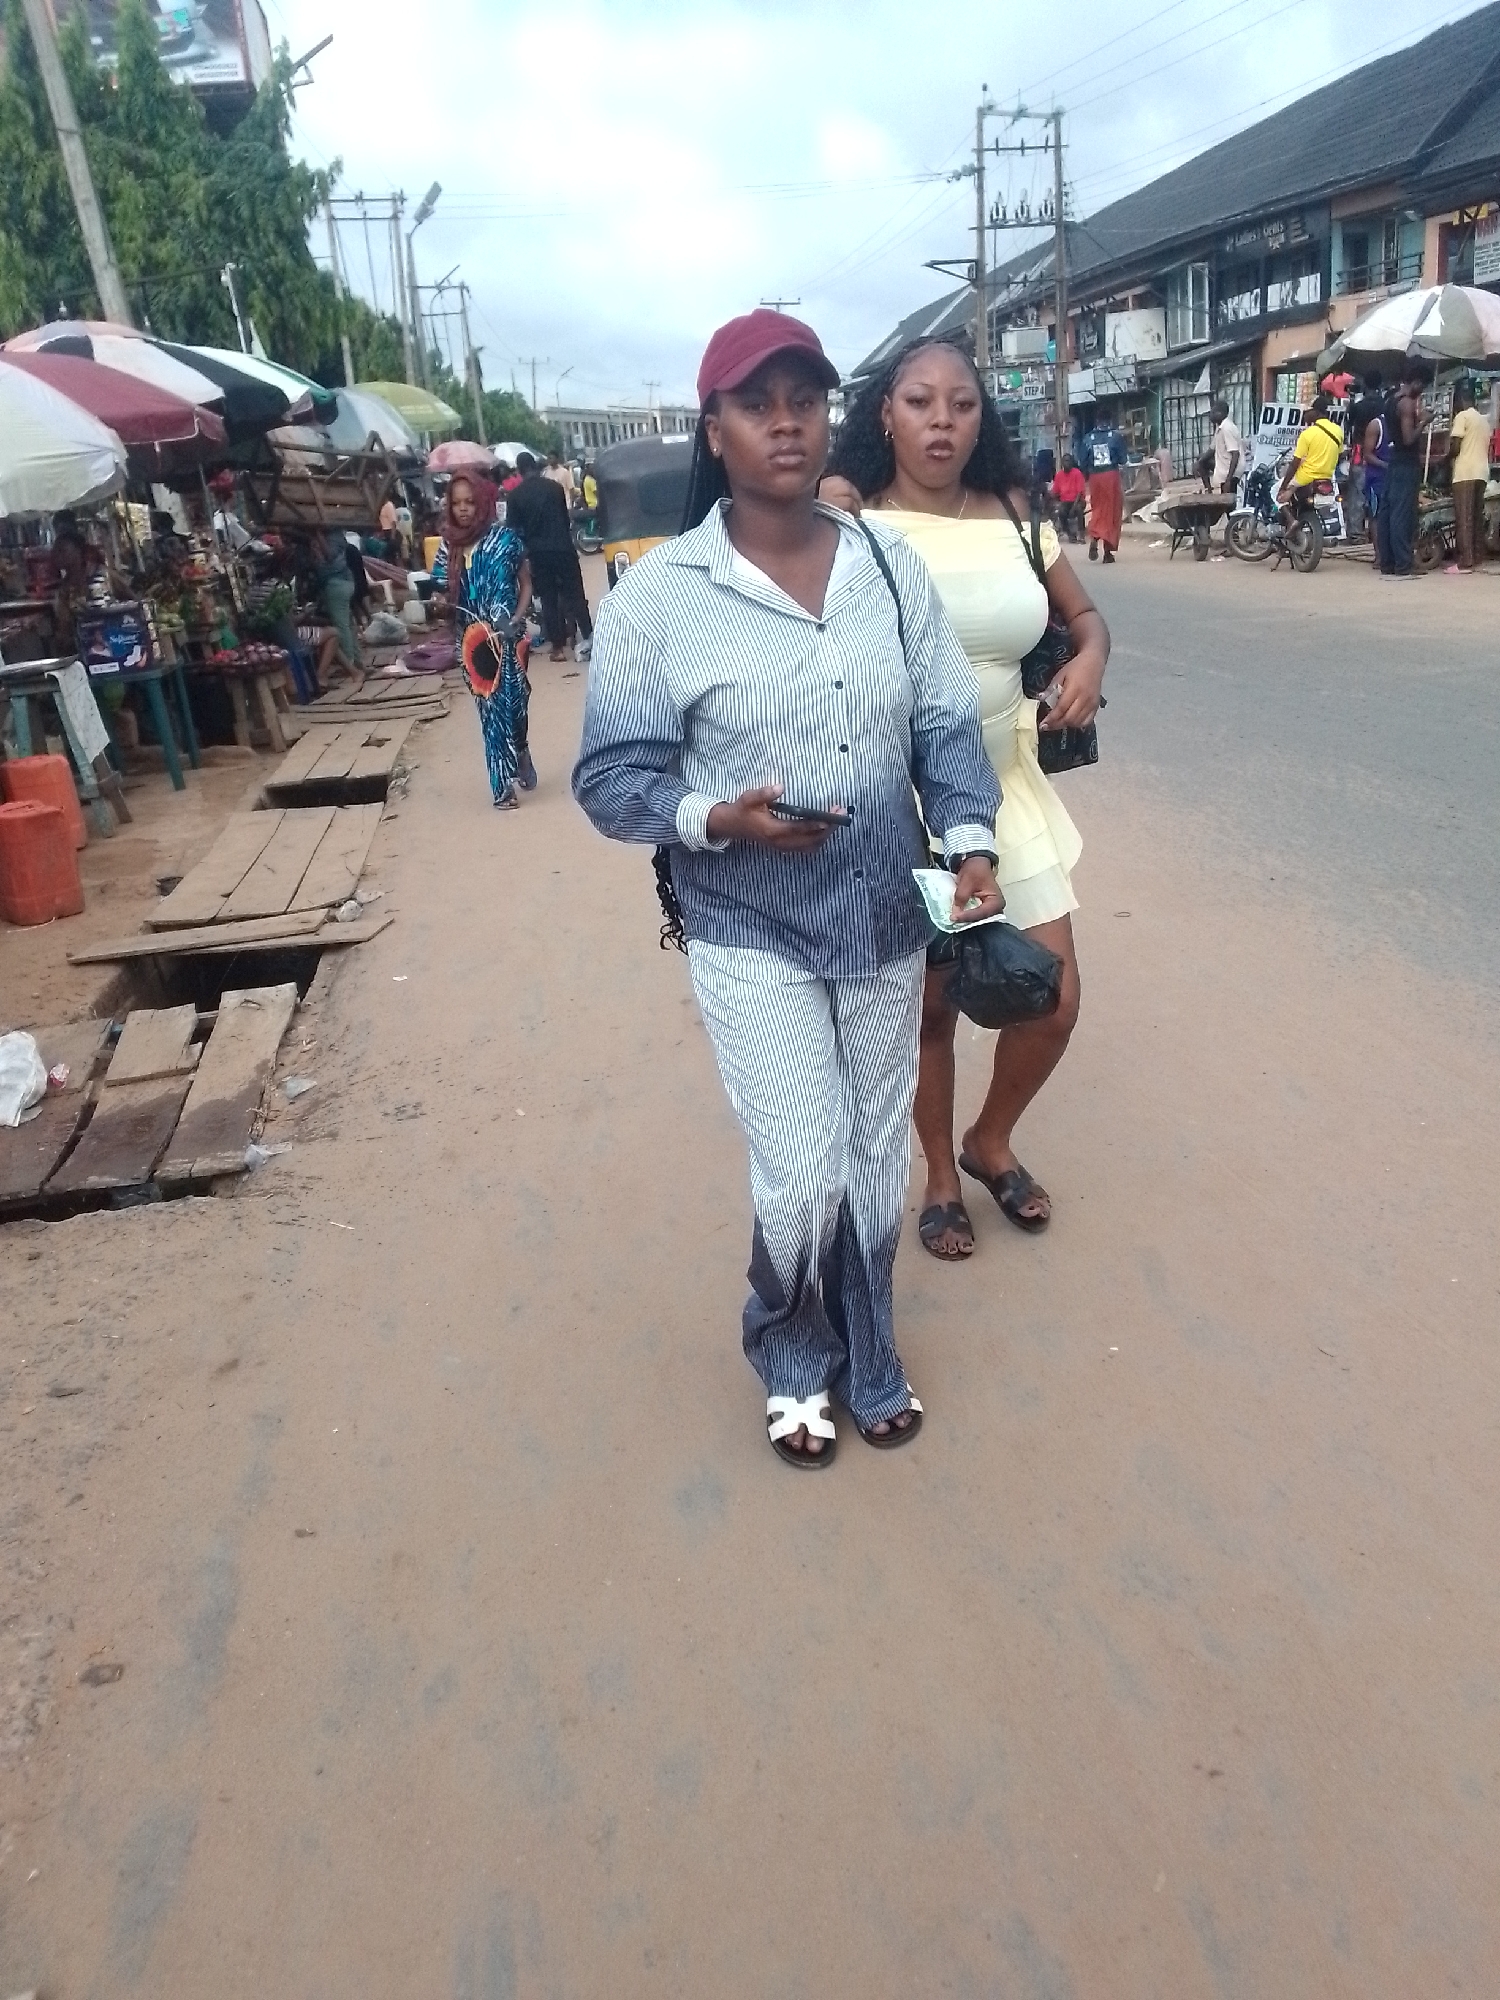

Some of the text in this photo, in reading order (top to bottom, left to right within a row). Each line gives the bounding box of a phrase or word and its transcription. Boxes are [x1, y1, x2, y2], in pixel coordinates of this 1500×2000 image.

[1024, 386, 1039, 396] STEP
[1040, 386, 1045, 395] 4
[1262, 406, 1283, 425] DJ
